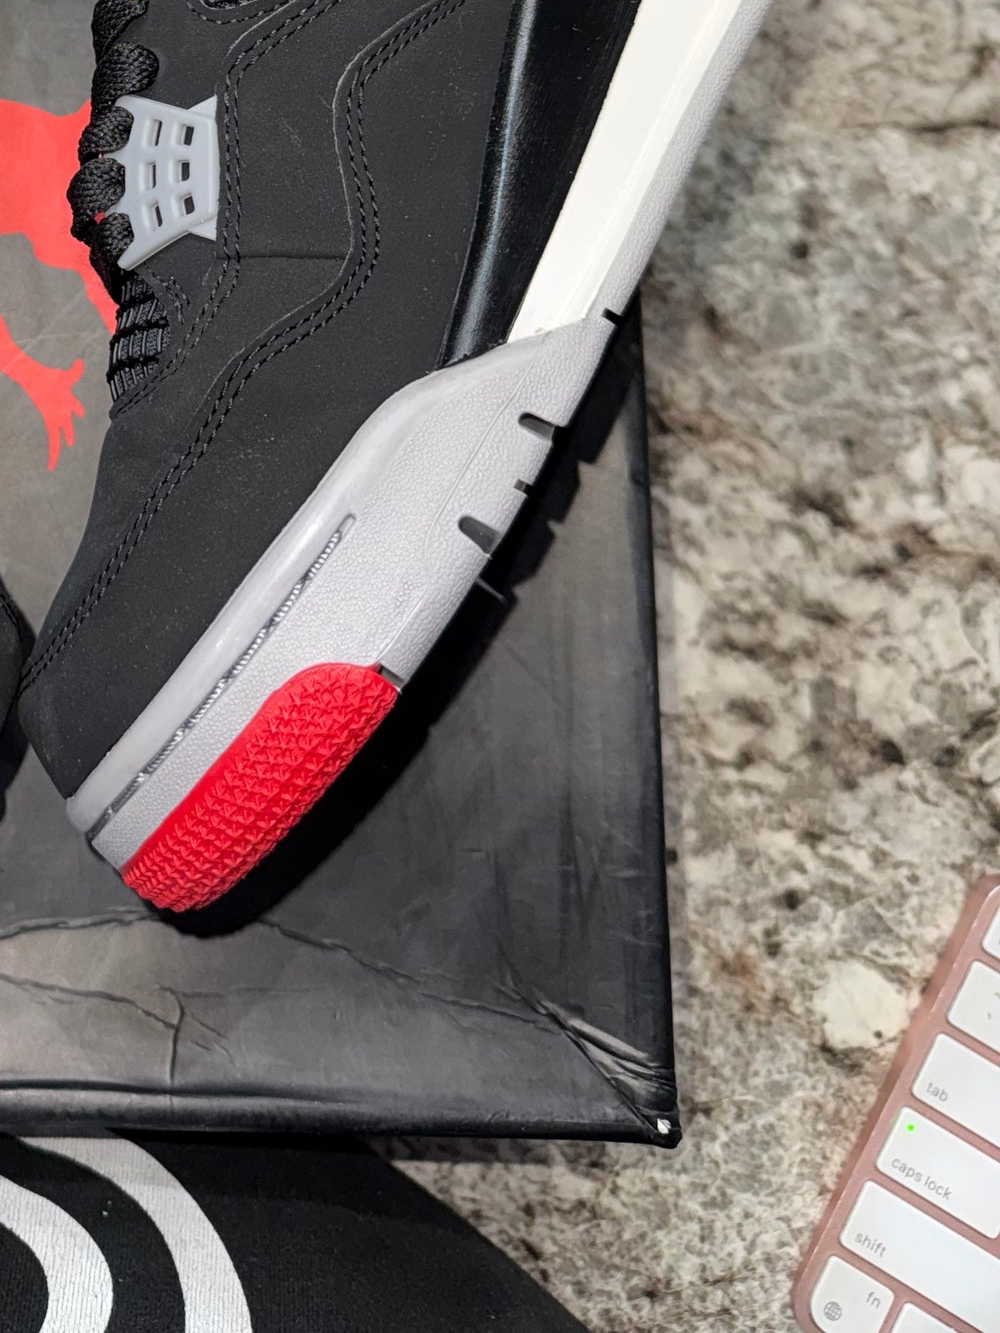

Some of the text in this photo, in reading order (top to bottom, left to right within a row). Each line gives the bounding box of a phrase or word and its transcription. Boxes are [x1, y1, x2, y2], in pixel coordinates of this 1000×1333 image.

[926, 1082, 949, 1102] tab
[891, 1157, 952, 1201] caps lock
[854, 1231, 887, 1258] shift
[866, 1291, 881, 1309] fn
